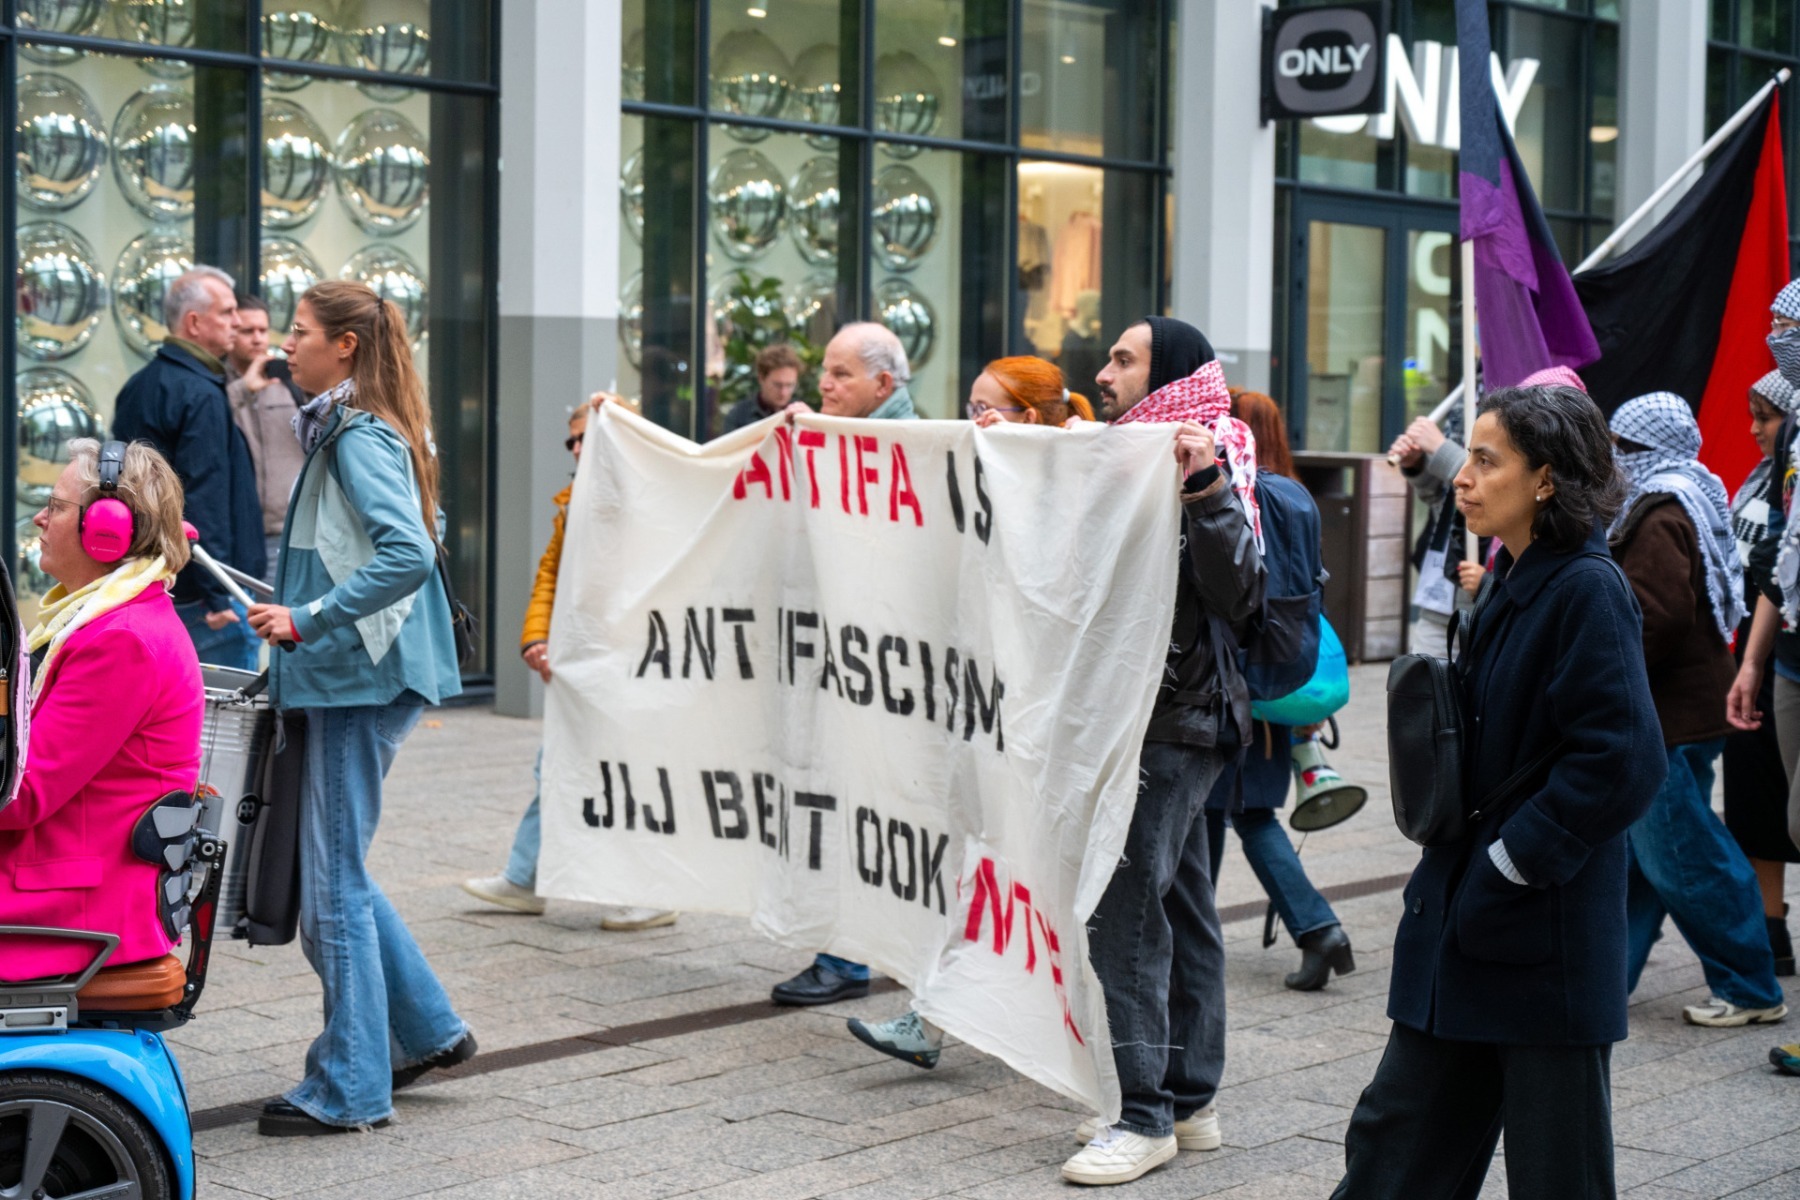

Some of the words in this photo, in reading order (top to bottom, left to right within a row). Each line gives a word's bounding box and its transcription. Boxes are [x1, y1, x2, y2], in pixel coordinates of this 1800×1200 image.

[1278, 43, 1371, 78] ONLY
[733, 426, 923, 527] ANTIFA
[946, 450, 993, 547] IS
[582, 760, 676, 834] JIJ
[700, 770, 837, 870] BENT
[856, 806, 949, 916] OOK
